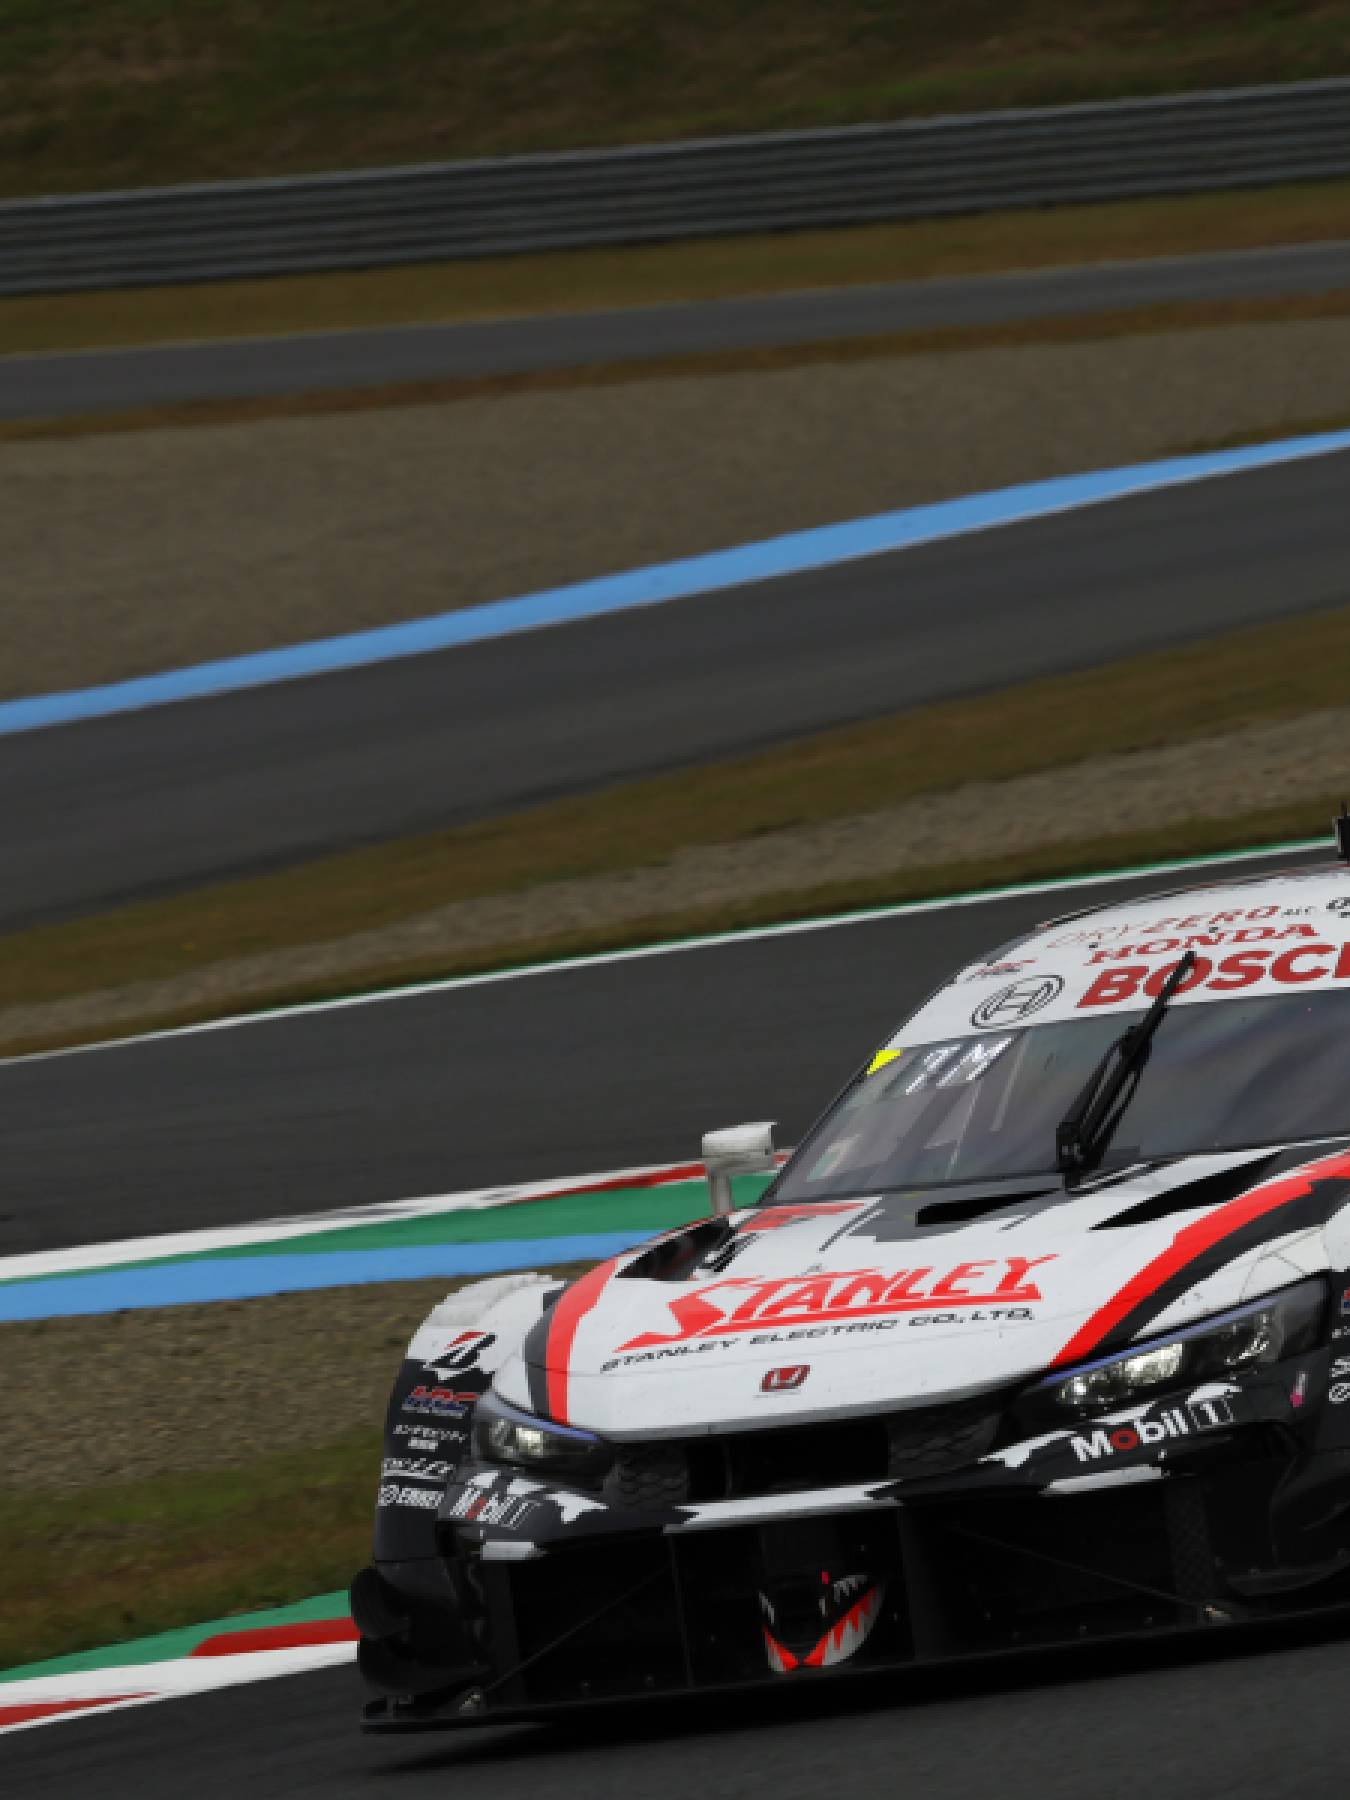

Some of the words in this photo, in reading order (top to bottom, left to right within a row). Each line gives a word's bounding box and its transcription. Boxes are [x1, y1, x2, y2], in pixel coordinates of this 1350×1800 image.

[1085, 925, 1319, 966] HONDA
[613, 1253, 1056, 1353] STANLEY
[601, 1338, 738, 1374] STANLEY
[748, 1320, 898, 1345] ELECTRIC
[1070, 1409, 1189, 1462] Mobil
